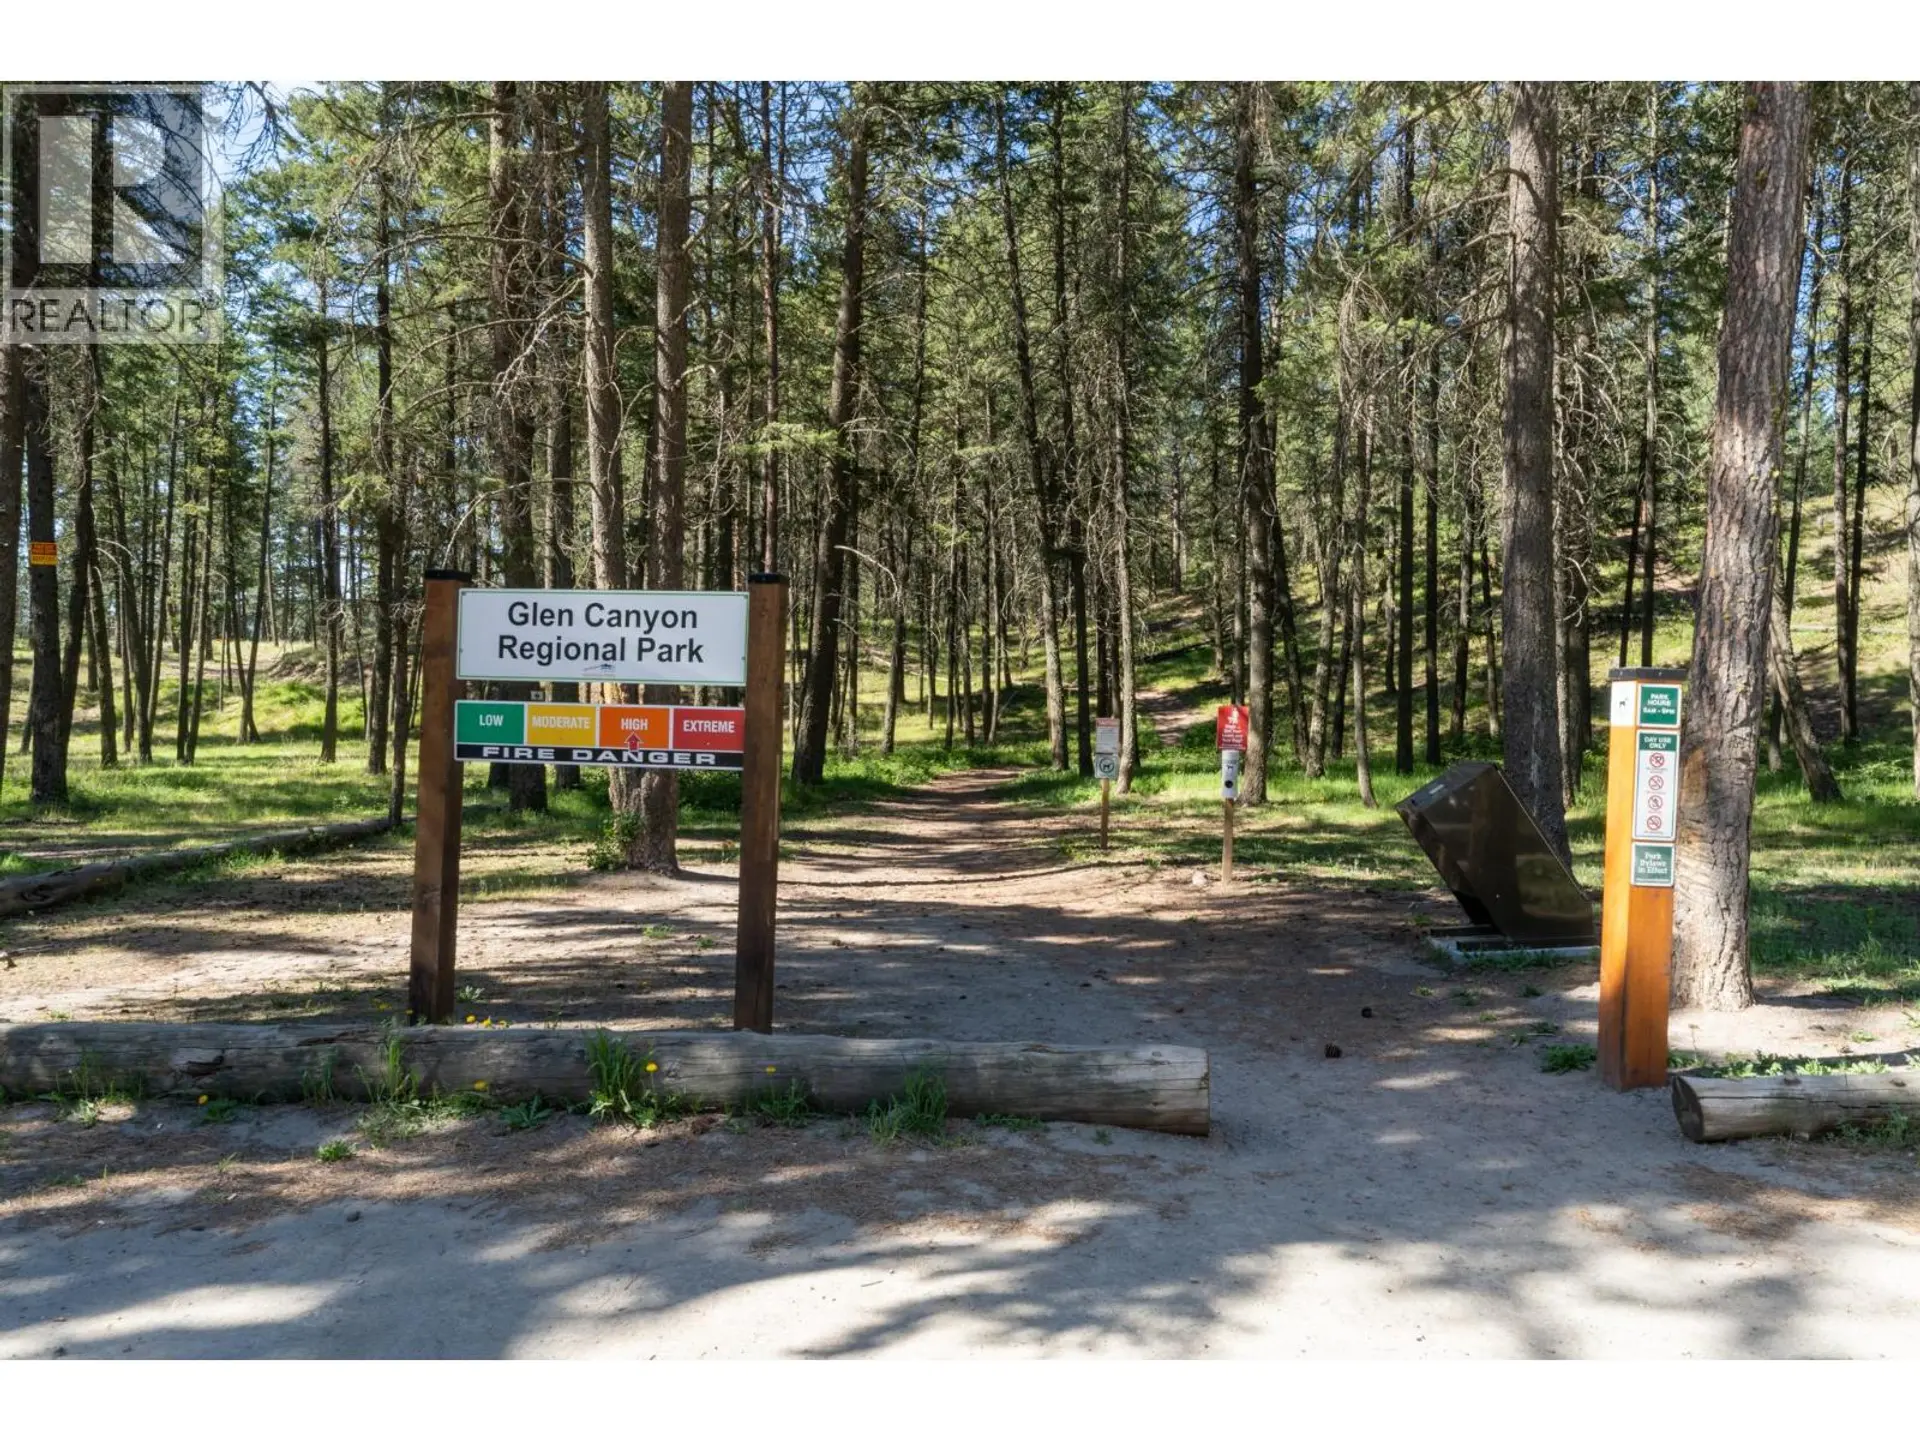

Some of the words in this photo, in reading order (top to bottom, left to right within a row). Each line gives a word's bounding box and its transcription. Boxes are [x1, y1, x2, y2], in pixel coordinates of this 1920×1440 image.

[507, 601, 574, 627] Glen
[584, 602, 698, 635] Canyon
[498, 634, 626, 666] Regional
[637, 638, 704, 664] Park
[478, 714, 504, 727] LOW
[531, 716, 591, 730] MODERATE
[620, 718, 649, 731] HIGH
[683, 719, 736, 734] EXTREME
[482, 746, 556, 760] FIRE
[572, 748, 717, 766] DANGER
